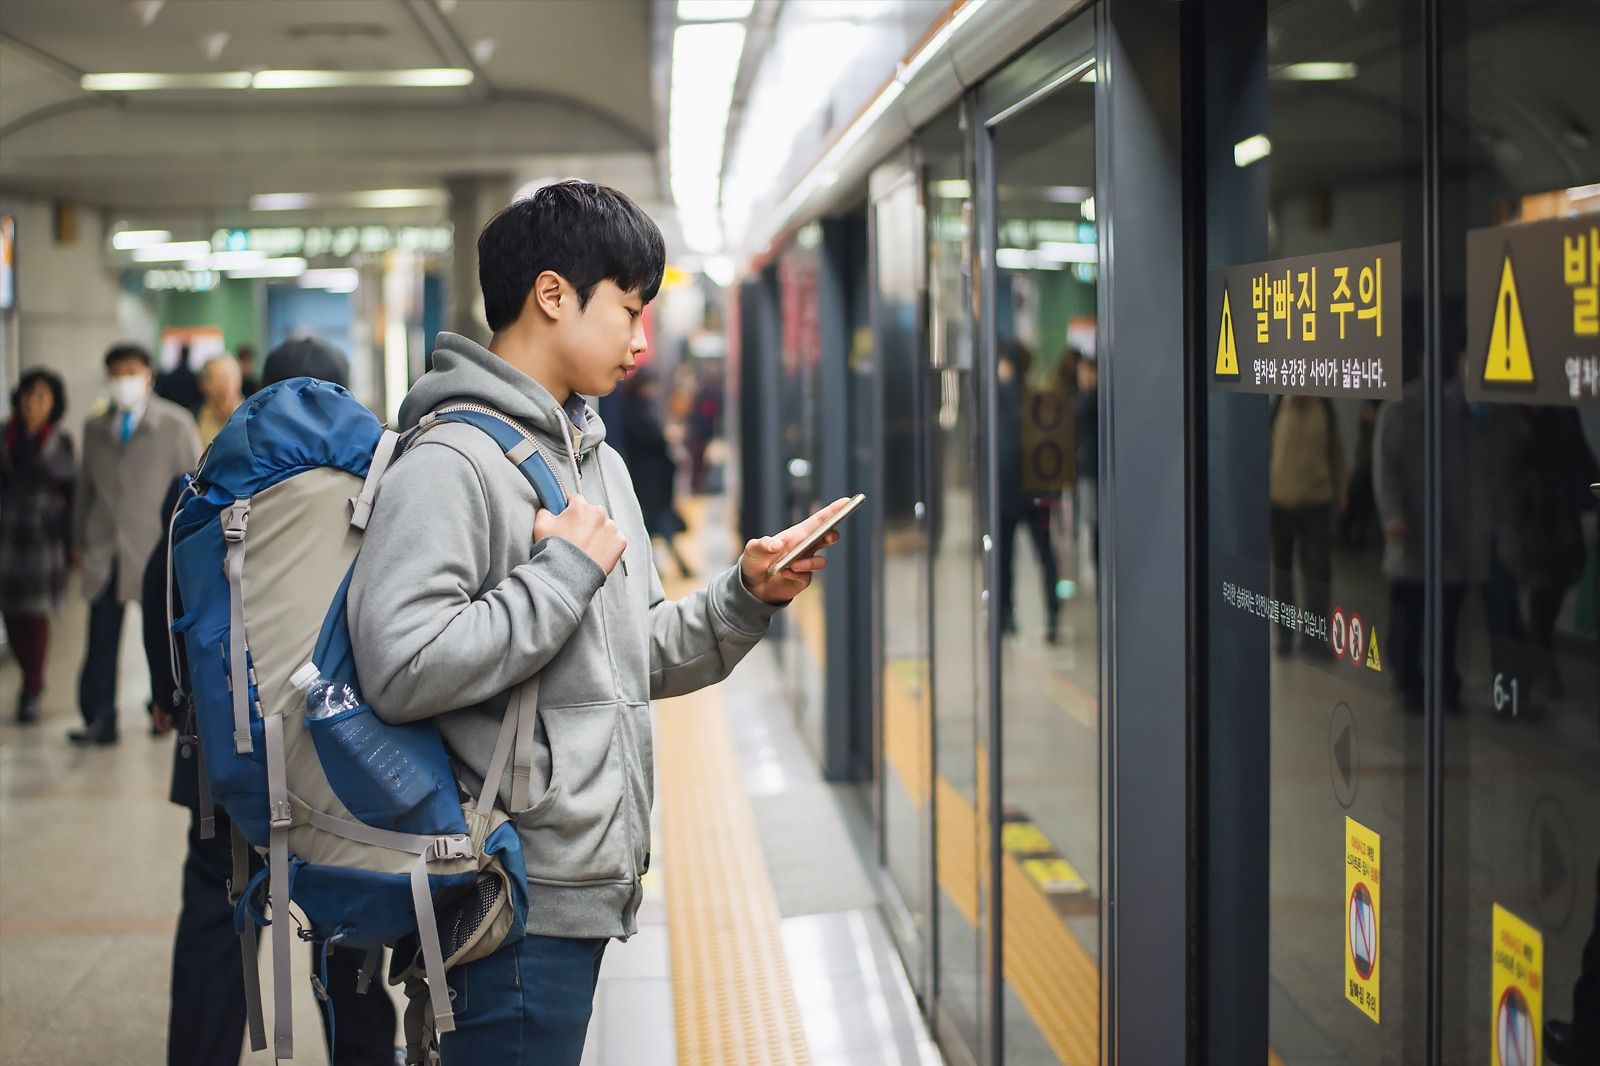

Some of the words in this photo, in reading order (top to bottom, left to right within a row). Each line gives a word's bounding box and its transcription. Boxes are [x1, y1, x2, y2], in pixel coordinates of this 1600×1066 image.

[1252, 266, 1316, 343] 발빠짐
[1330, 258, 1382, 339] 주의
[1253, 358, 1277, 385] 열차와
[1280, 358, 1306, 386] 승강장
[1309, 358, 1338, 386] 사이가
[1341, 358, 1387, 388] 넓습니다.
[1280, 602, 1296, 630] 유발할
[1296, 607, 1304, 632] 수
[1304, 610, 1328, 642] 있습니다.
[1494, 672, 1518, 716] 6-1
